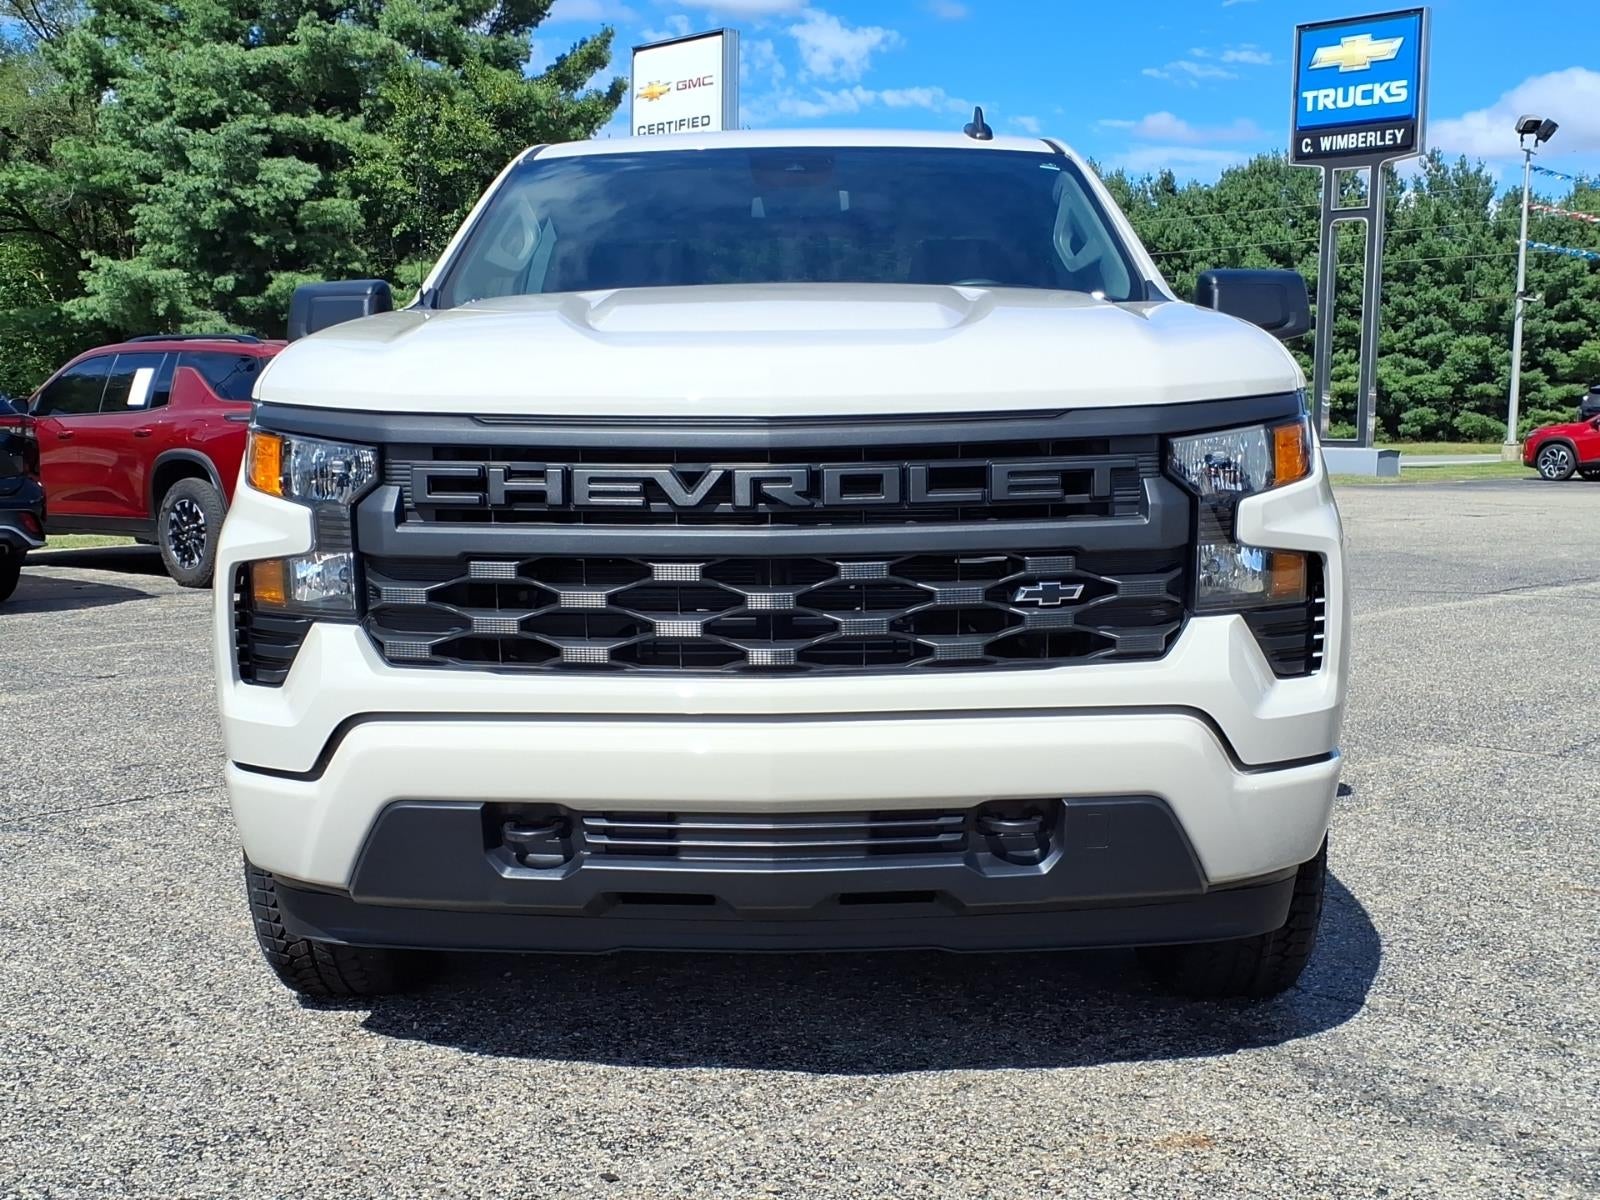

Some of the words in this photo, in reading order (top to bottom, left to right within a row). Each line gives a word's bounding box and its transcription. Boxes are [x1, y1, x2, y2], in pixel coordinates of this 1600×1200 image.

[676, 75, 714, 91] GMC
[1302, 79, 1408, 112] TRUCKS
[637, 115, 711, 136] CERTIFIED
[1301, 138, 1313, 153] C.
[1320, 128, 1405, 151] WIMBERLEY
[411, 459, 1137, 508] CHEVROLET
